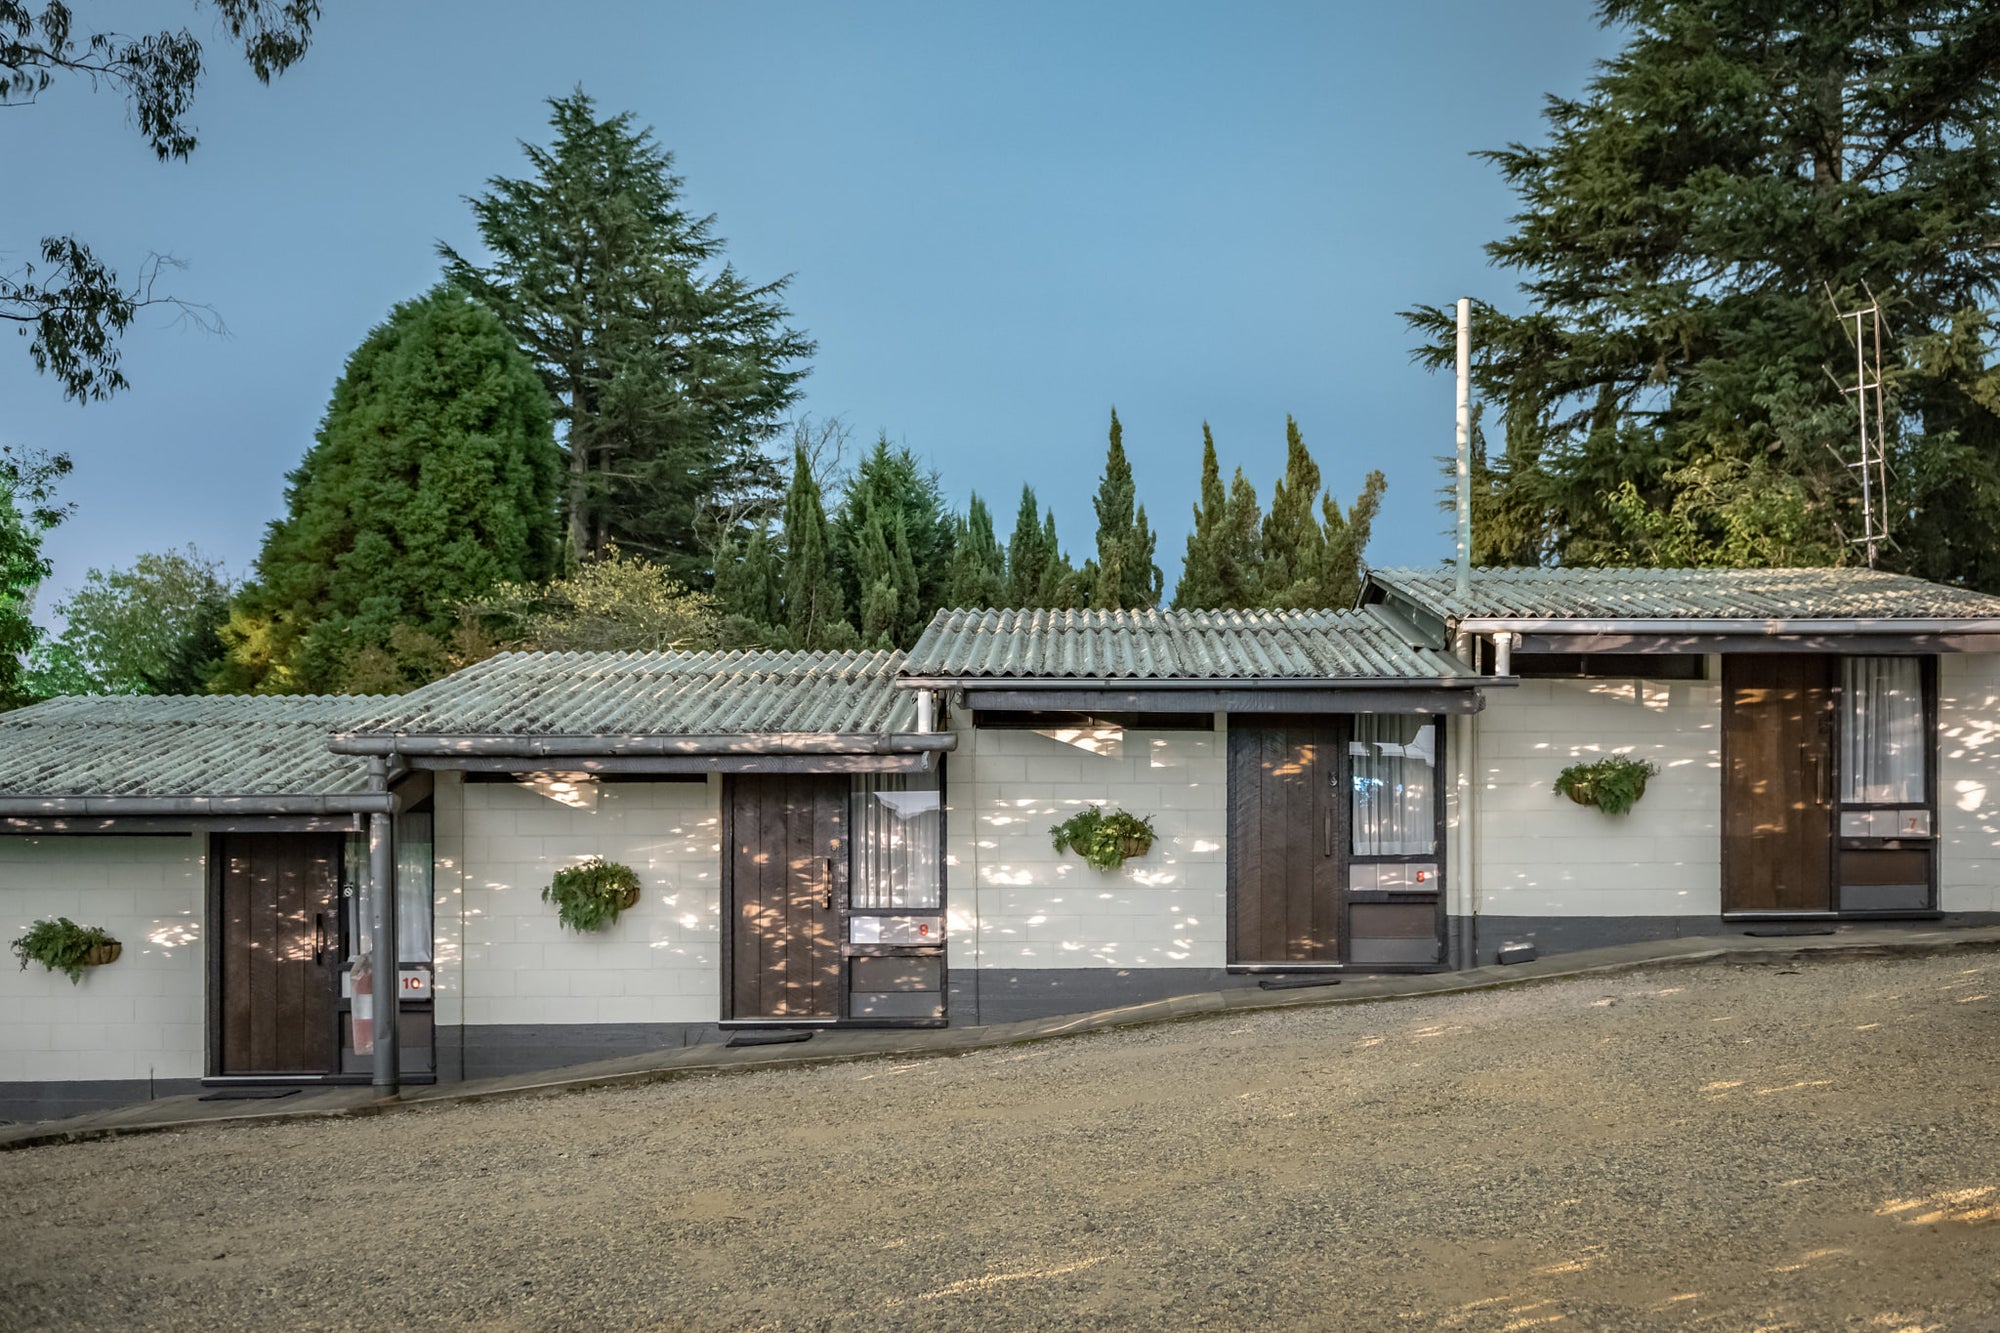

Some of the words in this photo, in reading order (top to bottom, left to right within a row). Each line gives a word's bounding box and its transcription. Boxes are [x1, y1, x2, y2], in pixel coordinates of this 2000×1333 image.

[1909, 817, 1918, 829] 7
[1416, 870, 1425, 883] 8
[919, 924, 928, 936] 9
[402, 977, 421, 989] 10
